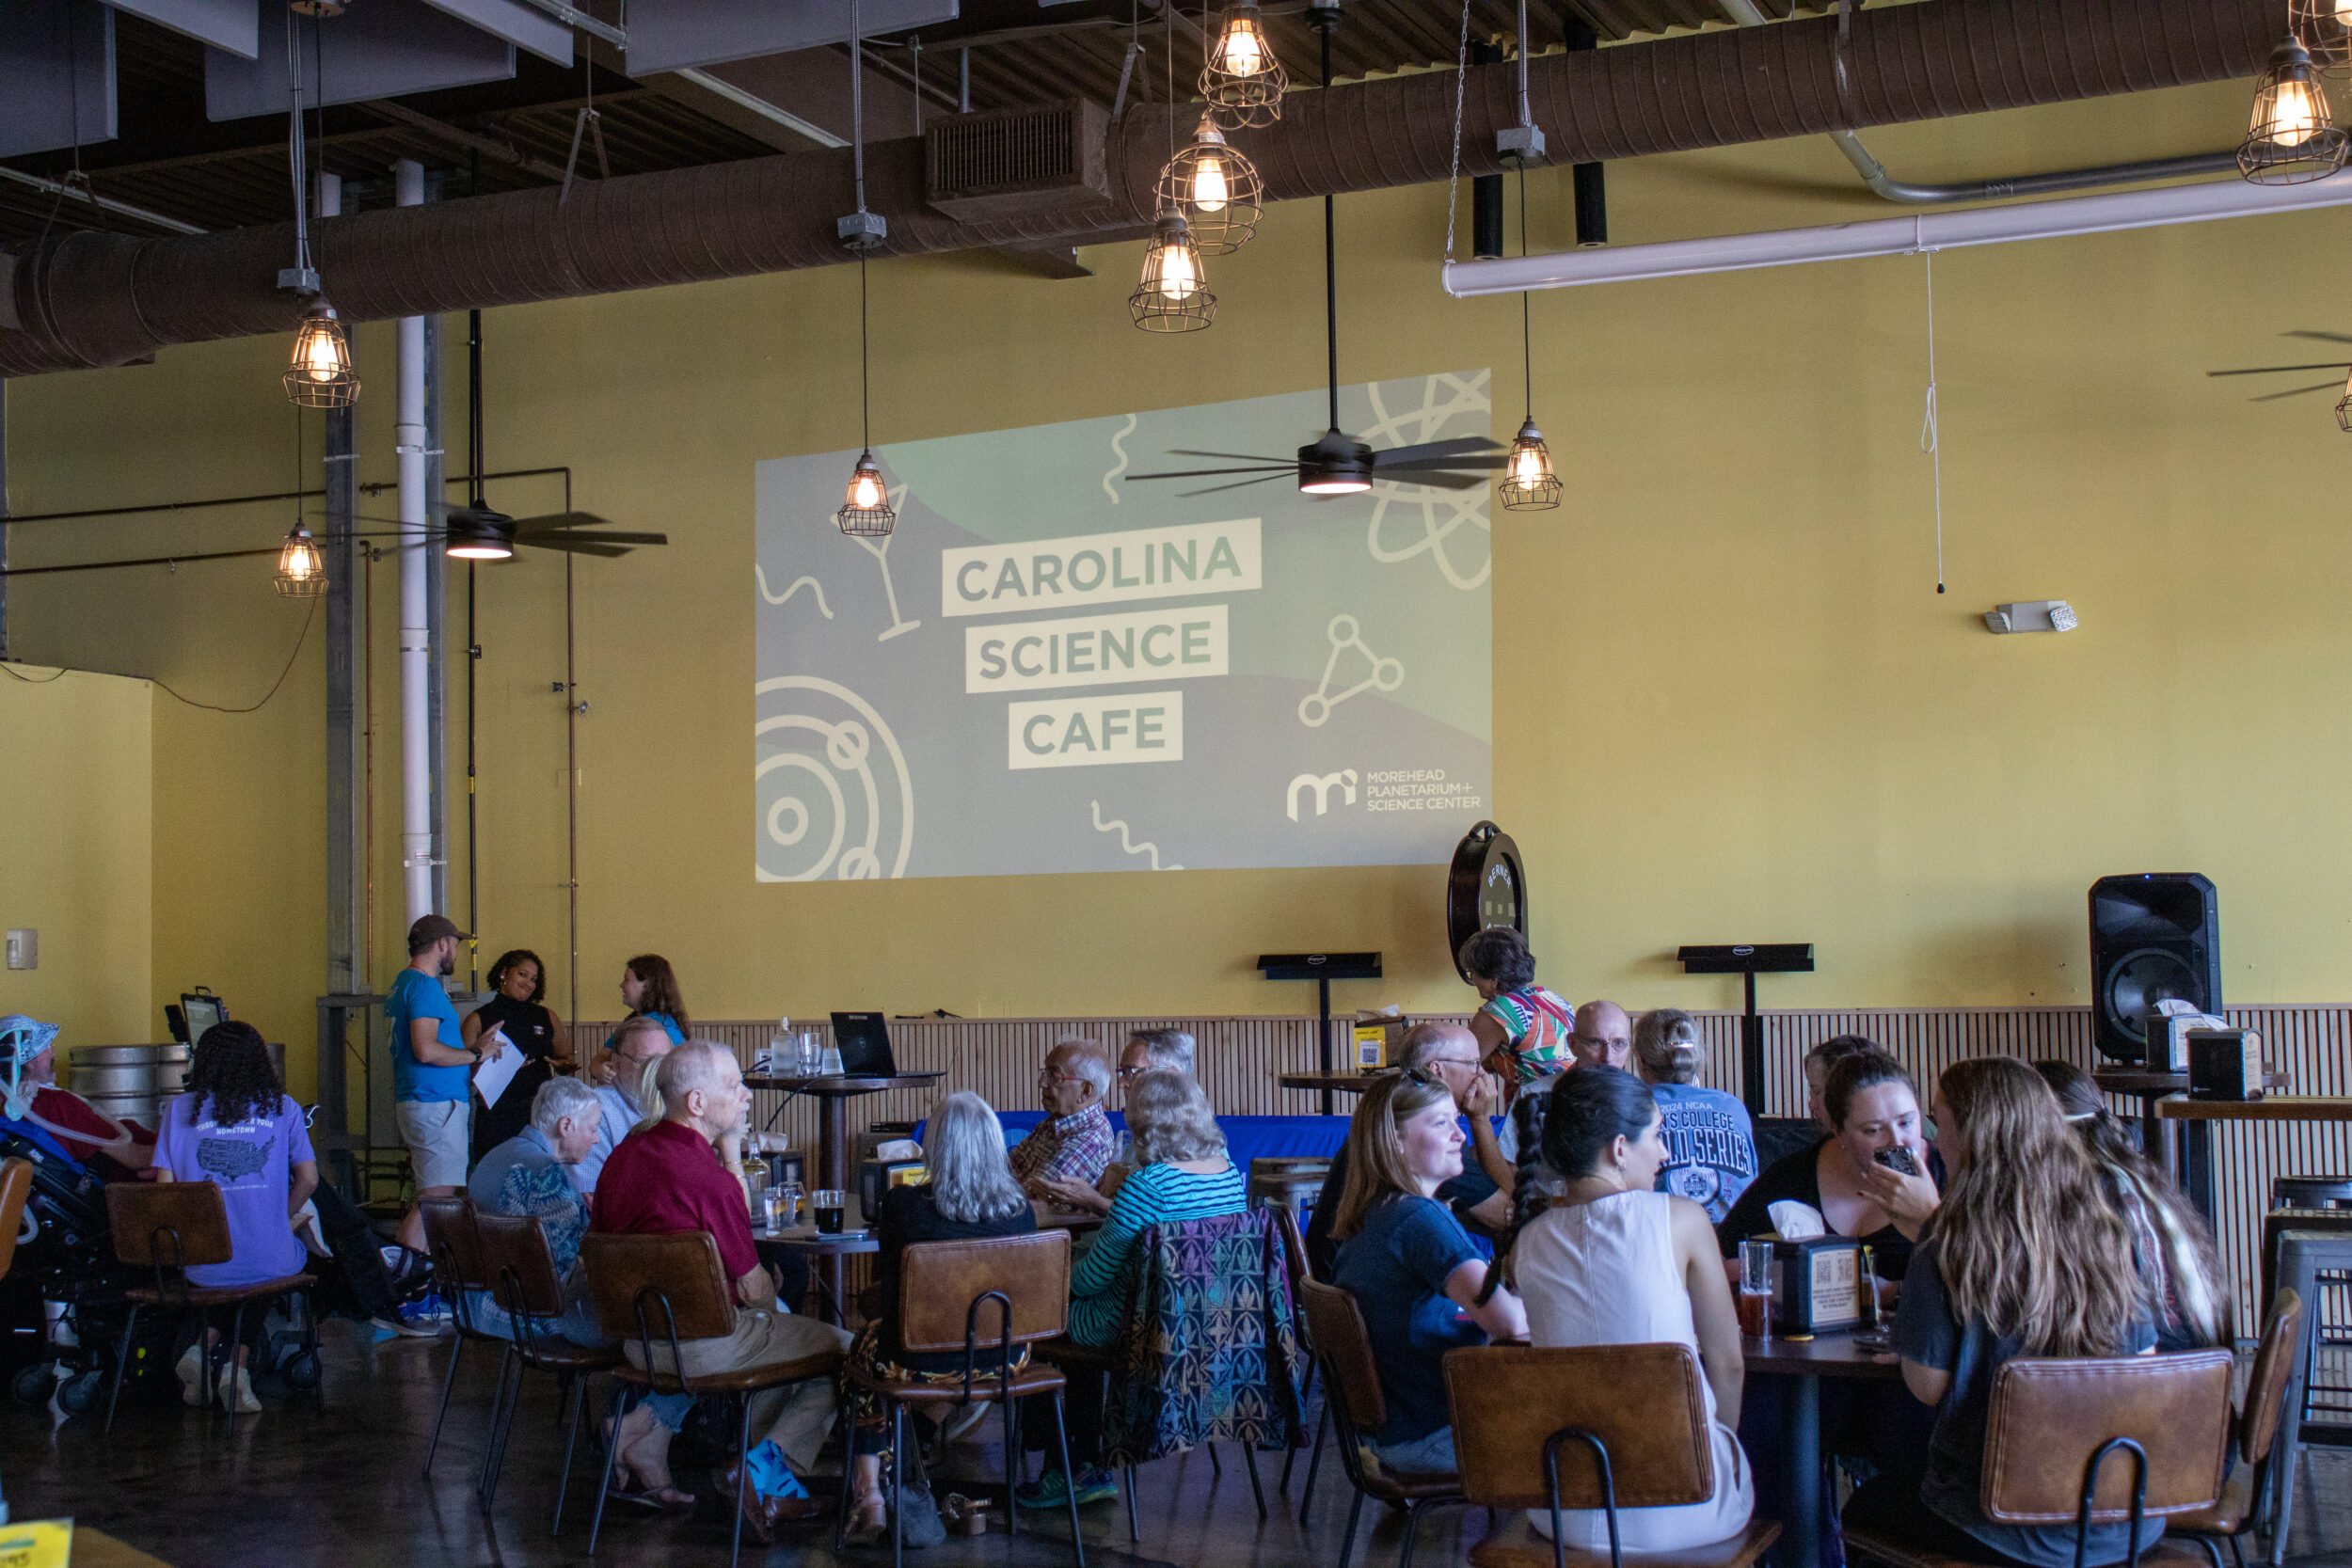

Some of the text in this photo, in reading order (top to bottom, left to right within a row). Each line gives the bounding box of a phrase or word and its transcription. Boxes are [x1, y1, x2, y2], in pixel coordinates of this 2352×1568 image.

[957, 536, 1242, 602] CAROLINA
[979, 621, 1211, 680] SCIENCE
[1023, 706, 1166, 755] CAFE
[1367, 769, 1445, 784] MOREHEAD
[1367, 797, 1481, 812] SCIENCE CENTER
[1487, 863, 1512, 890] BERNER
[1660, 1101, 1713, 1112] 2024 NCAA
[216, 1126, 256, 1135] HOMETOWN
[257, 1117, 274, 1129] YOUR
[1681, 1111, 1735, 1131] COLLEGE
[1693, 1128, 1750, 1176] SERIES
